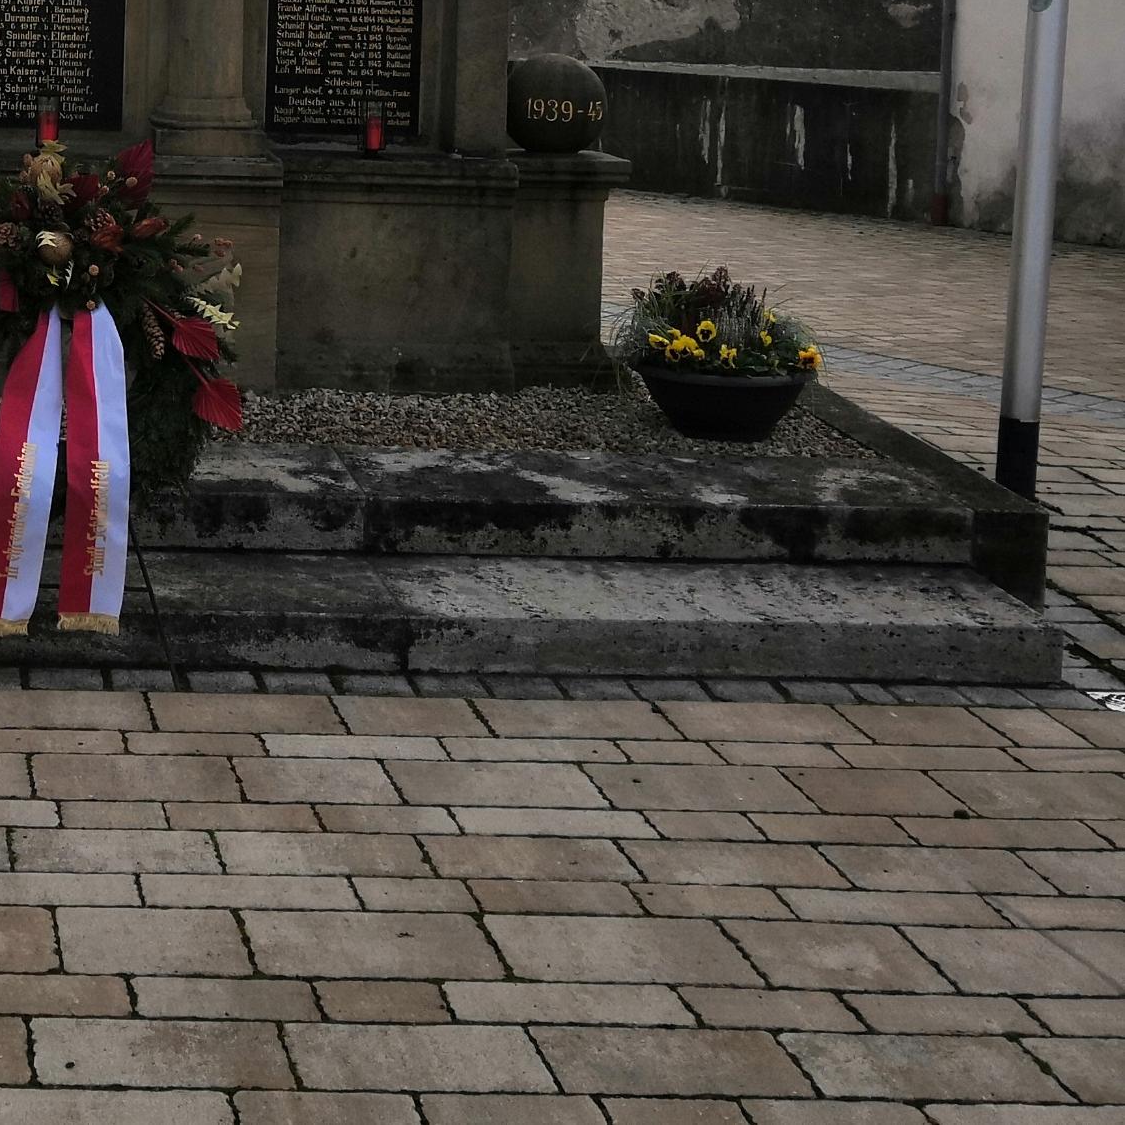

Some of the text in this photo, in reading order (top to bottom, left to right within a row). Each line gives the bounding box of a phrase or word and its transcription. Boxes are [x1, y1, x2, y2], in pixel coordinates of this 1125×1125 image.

[325, 77, 362, 87] Schlesien
[288, 96, 325, 105] Deutsche
[526, 97, 603, 122] 1939-45
[83, 460, 109, 576] Stadt Schlüsselfeld
